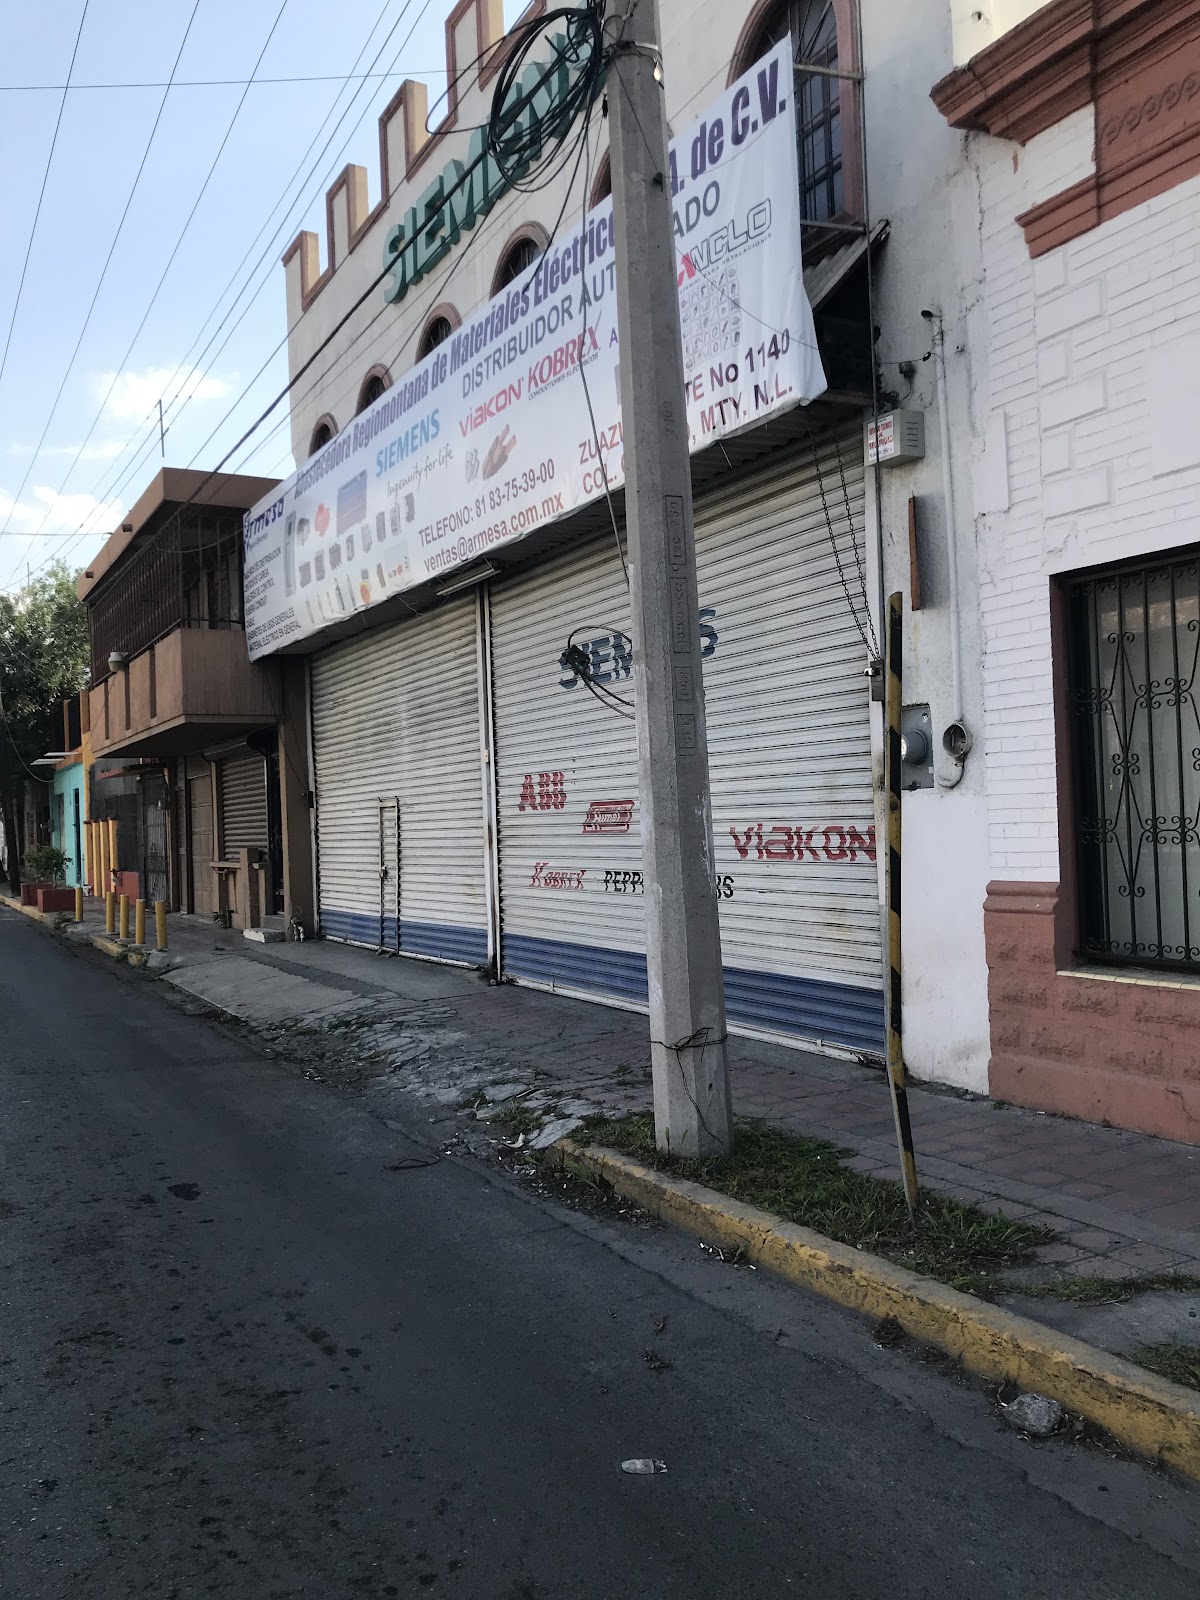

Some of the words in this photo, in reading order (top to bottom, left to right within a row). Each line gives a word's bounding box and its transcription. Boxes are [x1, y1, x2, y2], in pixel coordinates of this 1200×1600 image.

[352, 367, 429, 453] Regiomontana
[430, 346, 448, 391] de
[450, 282, 530, 376] Materiales
[691, 118, 725, 181] de
[731, 58, 786, 146] C.V.
[463, 295, 574, 398] DISTRIBUIDOR
[528, 316, 601, 393] KOBREX
[744, 327, 790, 374] 1140
[753, 372, 793, 411] N.L.
[375, 408, 441, 479] SIEMENS
[386, 461, 423, 501] Ingenuity
[424, 456, 437, 481] for
[438, 443, 455, 469] life
[418, 505, 474, 548] TELEFONO:
[475, 494, 487, 519] 81
[489, 458, 555, 511] 83-75-39-00
[423, 492, 565, 574] ventas@armesa.com.mx
